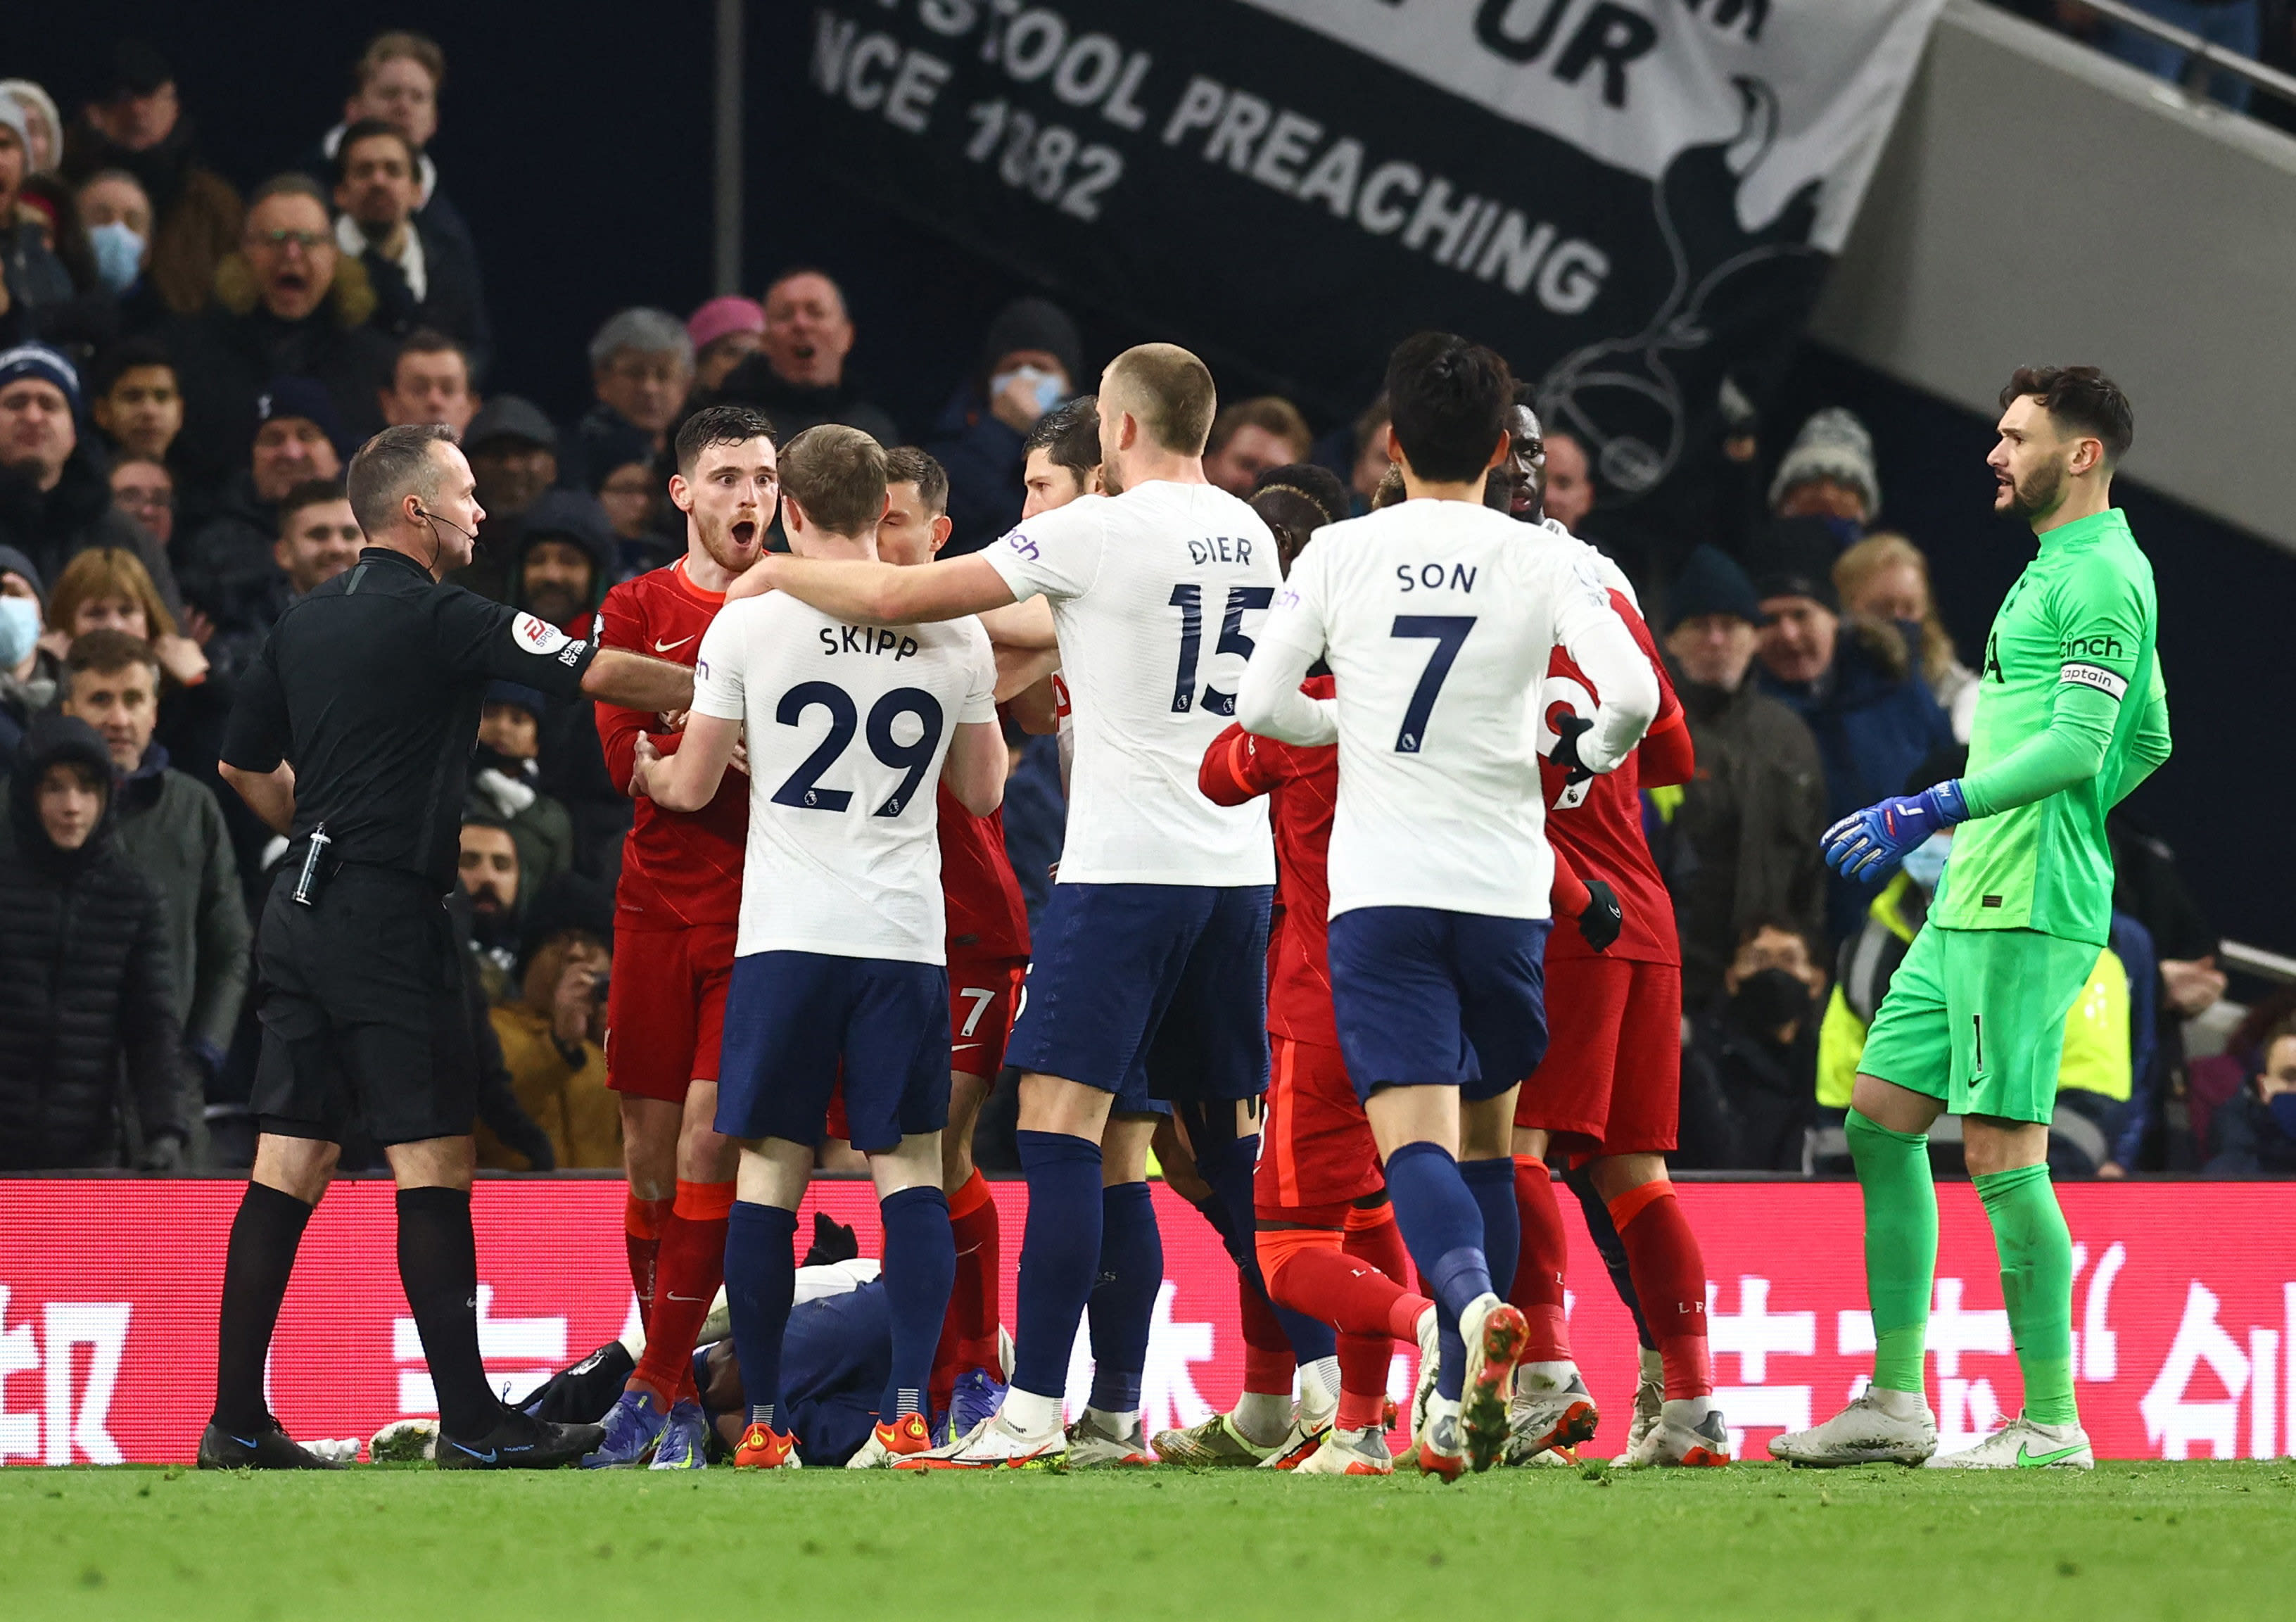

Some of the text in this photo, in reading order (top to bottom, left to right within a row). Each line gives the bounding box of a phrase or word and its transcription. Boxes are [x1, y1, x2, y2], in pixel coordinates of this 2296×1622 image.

[1161, 74, 1610, 315] PREACHING
[1187, 536, 1252, 566] DIER
[1397, 562, 1477, 594] SON
[535, 626, 558, 648] SPOR
[819, 625, 919, 662] SKIPP
[1168, 584, 1275, 716] 15
[1390, 614, 1478, 754] 7
[770, 680, 944, 818] 29
[958, 987, 996, 1037] 7
[1973, 1015, 1982, 1072] 1
